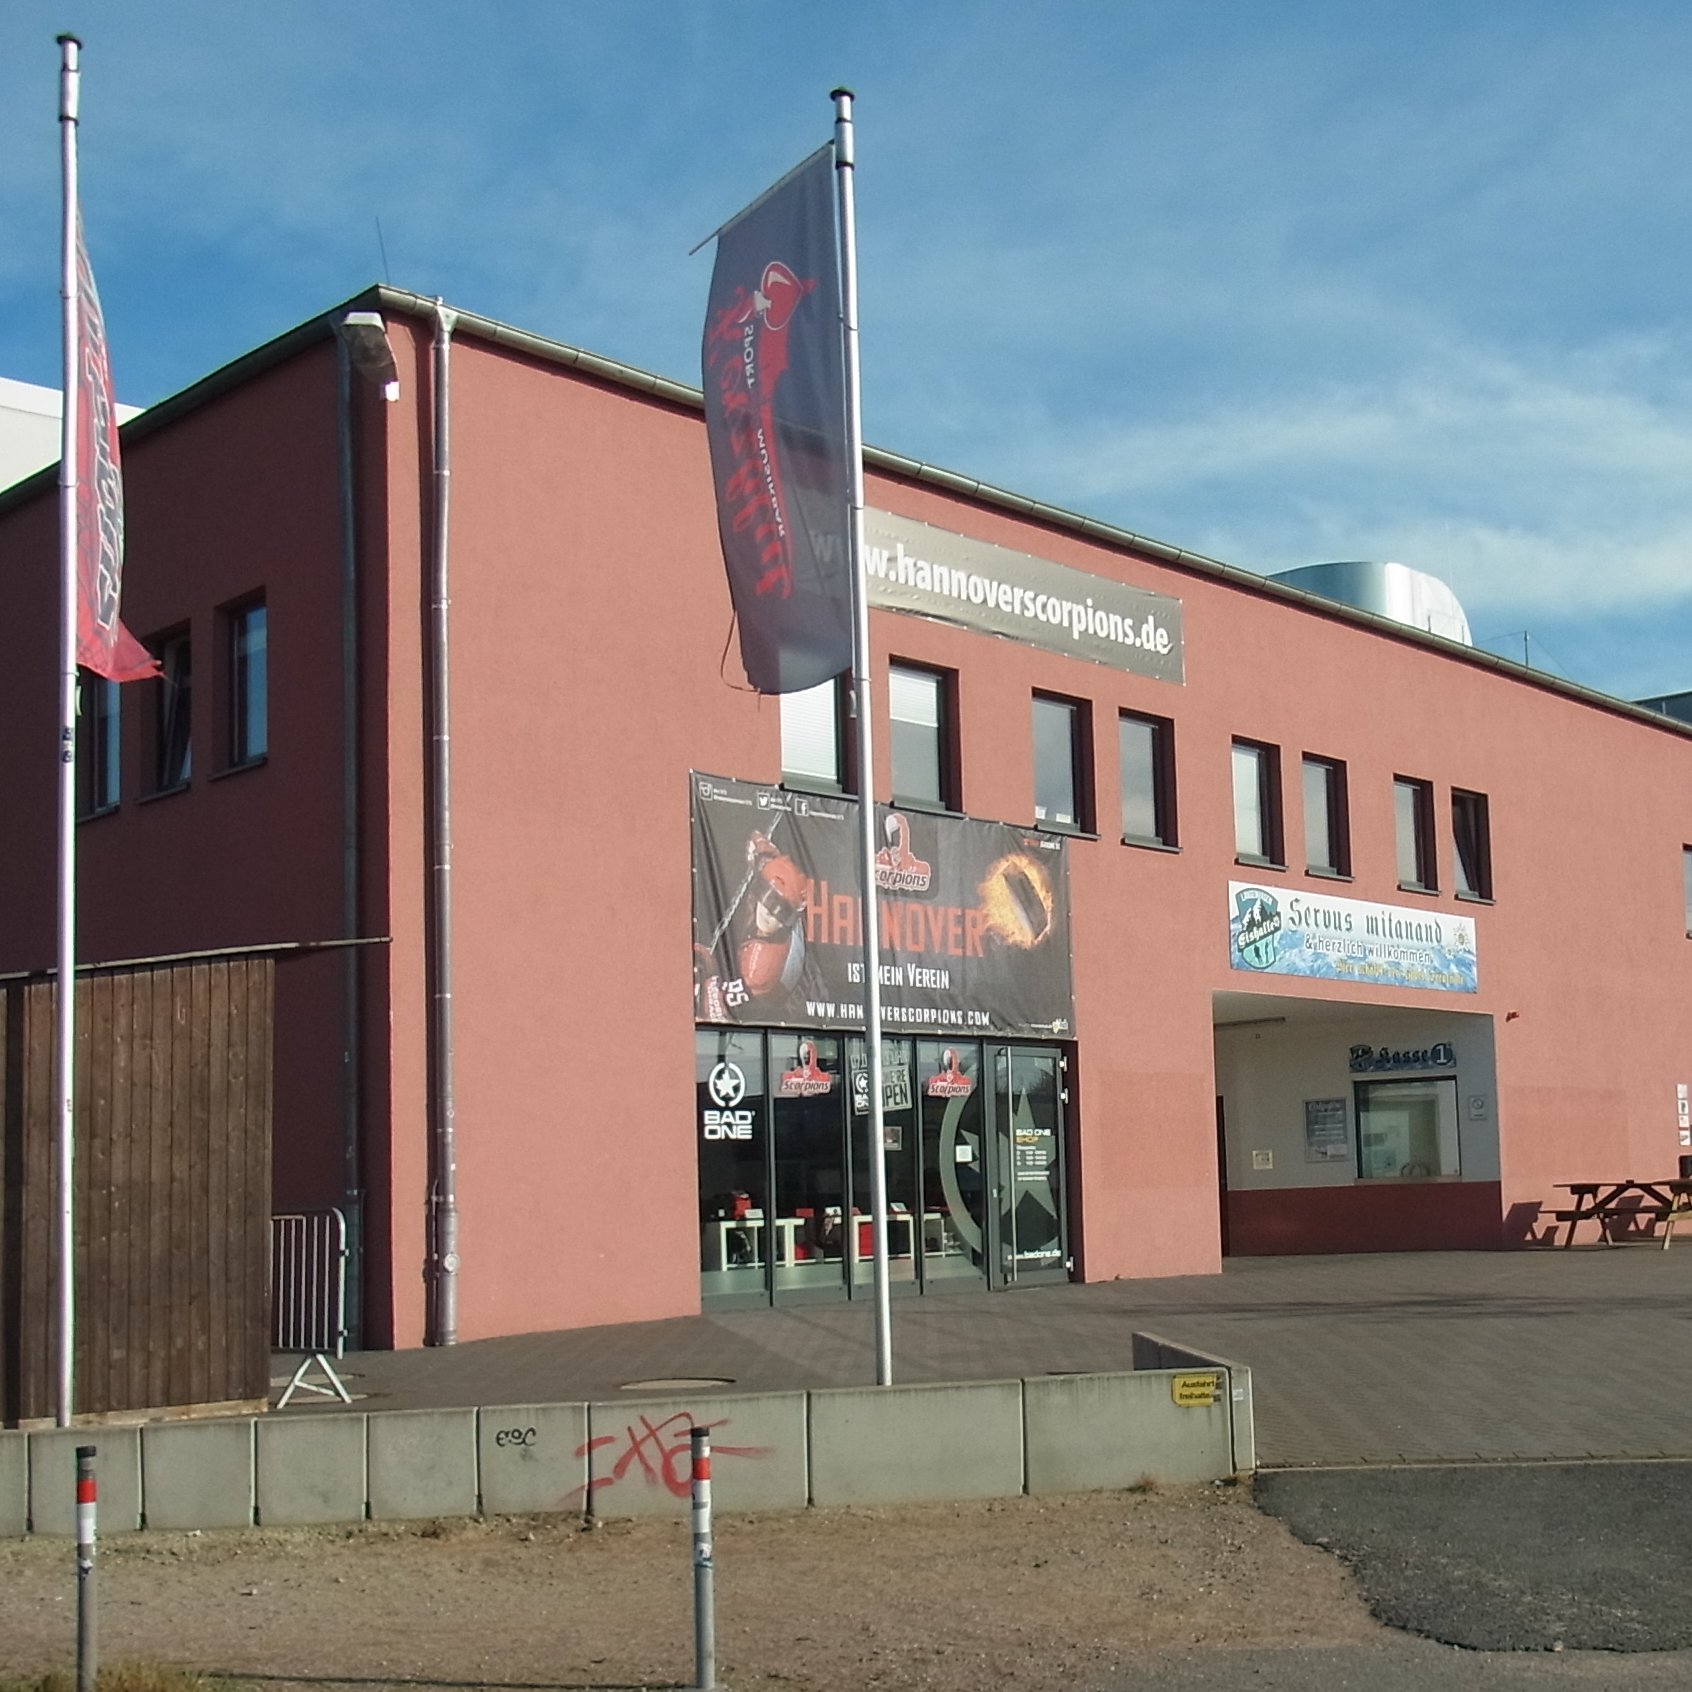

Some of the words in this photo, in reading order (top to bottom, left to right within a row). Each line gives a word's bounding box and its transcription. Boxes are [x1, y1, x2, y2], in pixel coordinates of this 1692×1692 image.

[875, 869, 927, 887] corpions
[1288, 898, 1353, 932] Servus
[1366, 911, 1443, 944] mitanand
[1305, 933, 1313, 950] &
[1317, 935, 1363, 956] herzlich
[907, 963, 950, 989] VEREIN
[806, 1001, 991, 1025] WWW.HANVERSCORPIONS.COM
[1436, 1044, 1448, 1063] 1
[784, 1080, 829, 1091] Scorpions
[931, 1084, 970, 1094] Scorpions
[704, 1110, 751, 1124] BAD
[704, 1125, 753, 1140] ONE
